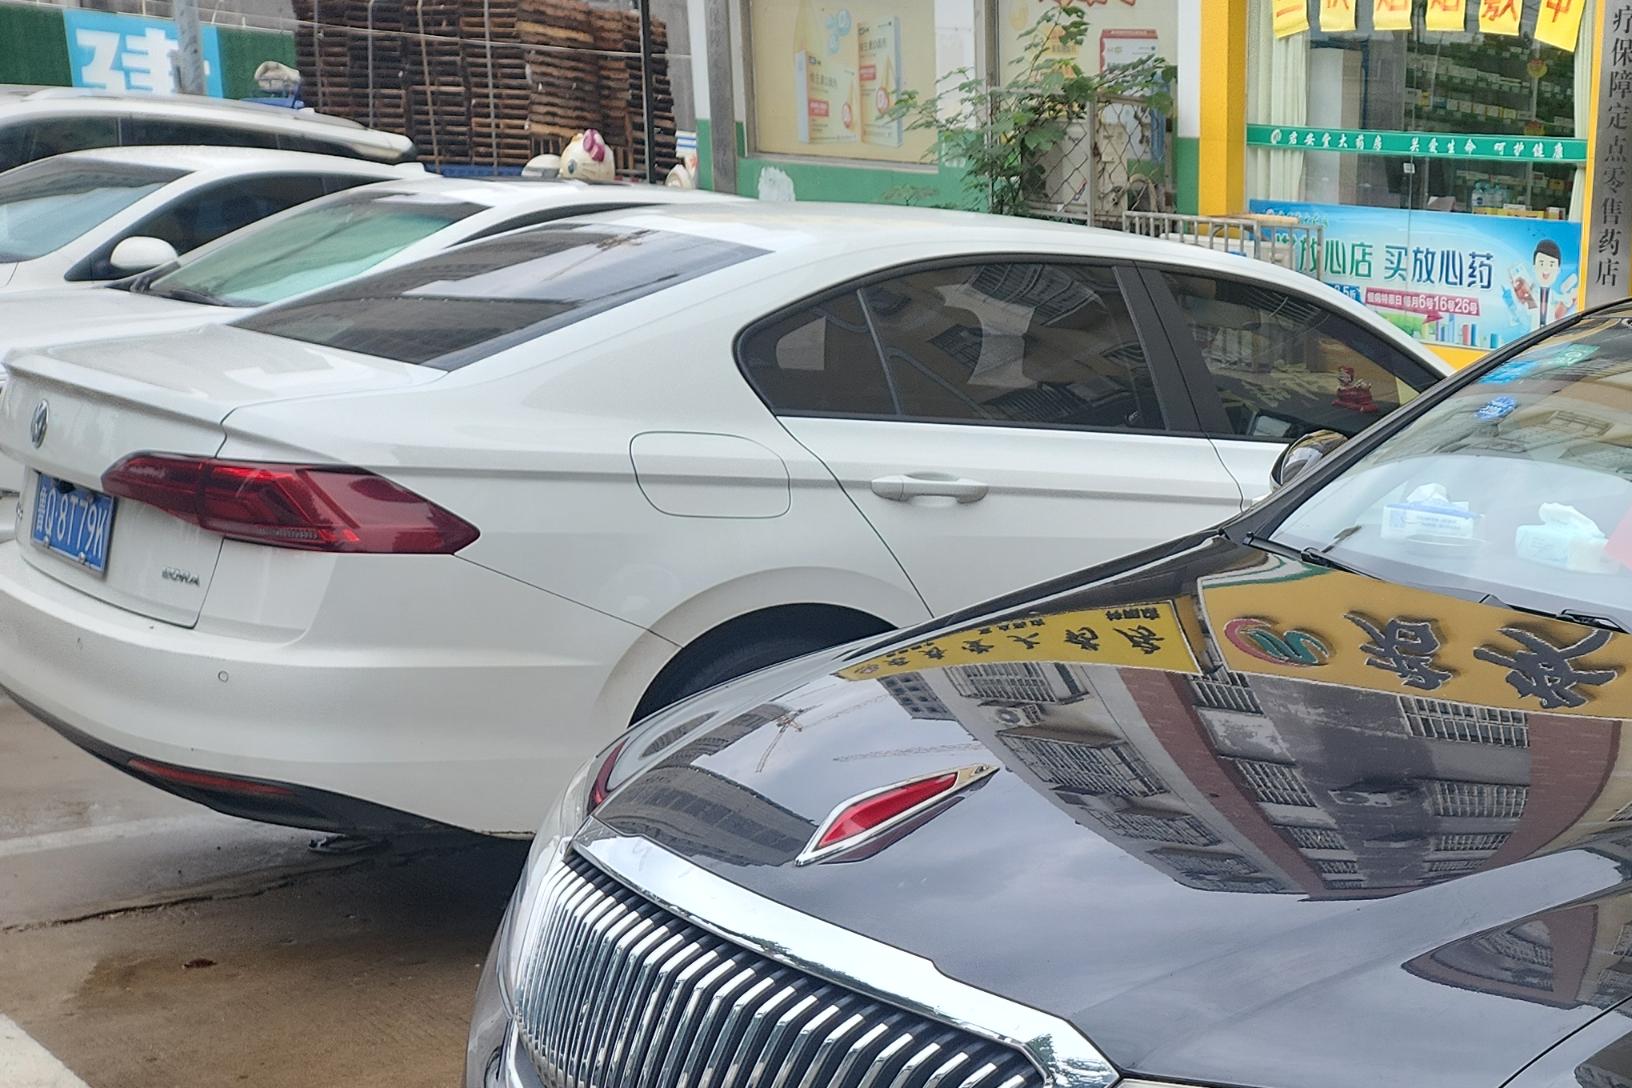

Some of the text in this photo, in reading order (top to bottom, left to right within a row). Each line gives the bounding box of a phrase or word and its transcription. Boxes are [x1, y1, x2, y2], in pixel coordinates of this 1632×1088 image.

[1287, 130, 1565, 160] 君安堂大药房 关爱生命 呵护健康
[1384, 244, 1494, 289] 买放心药
